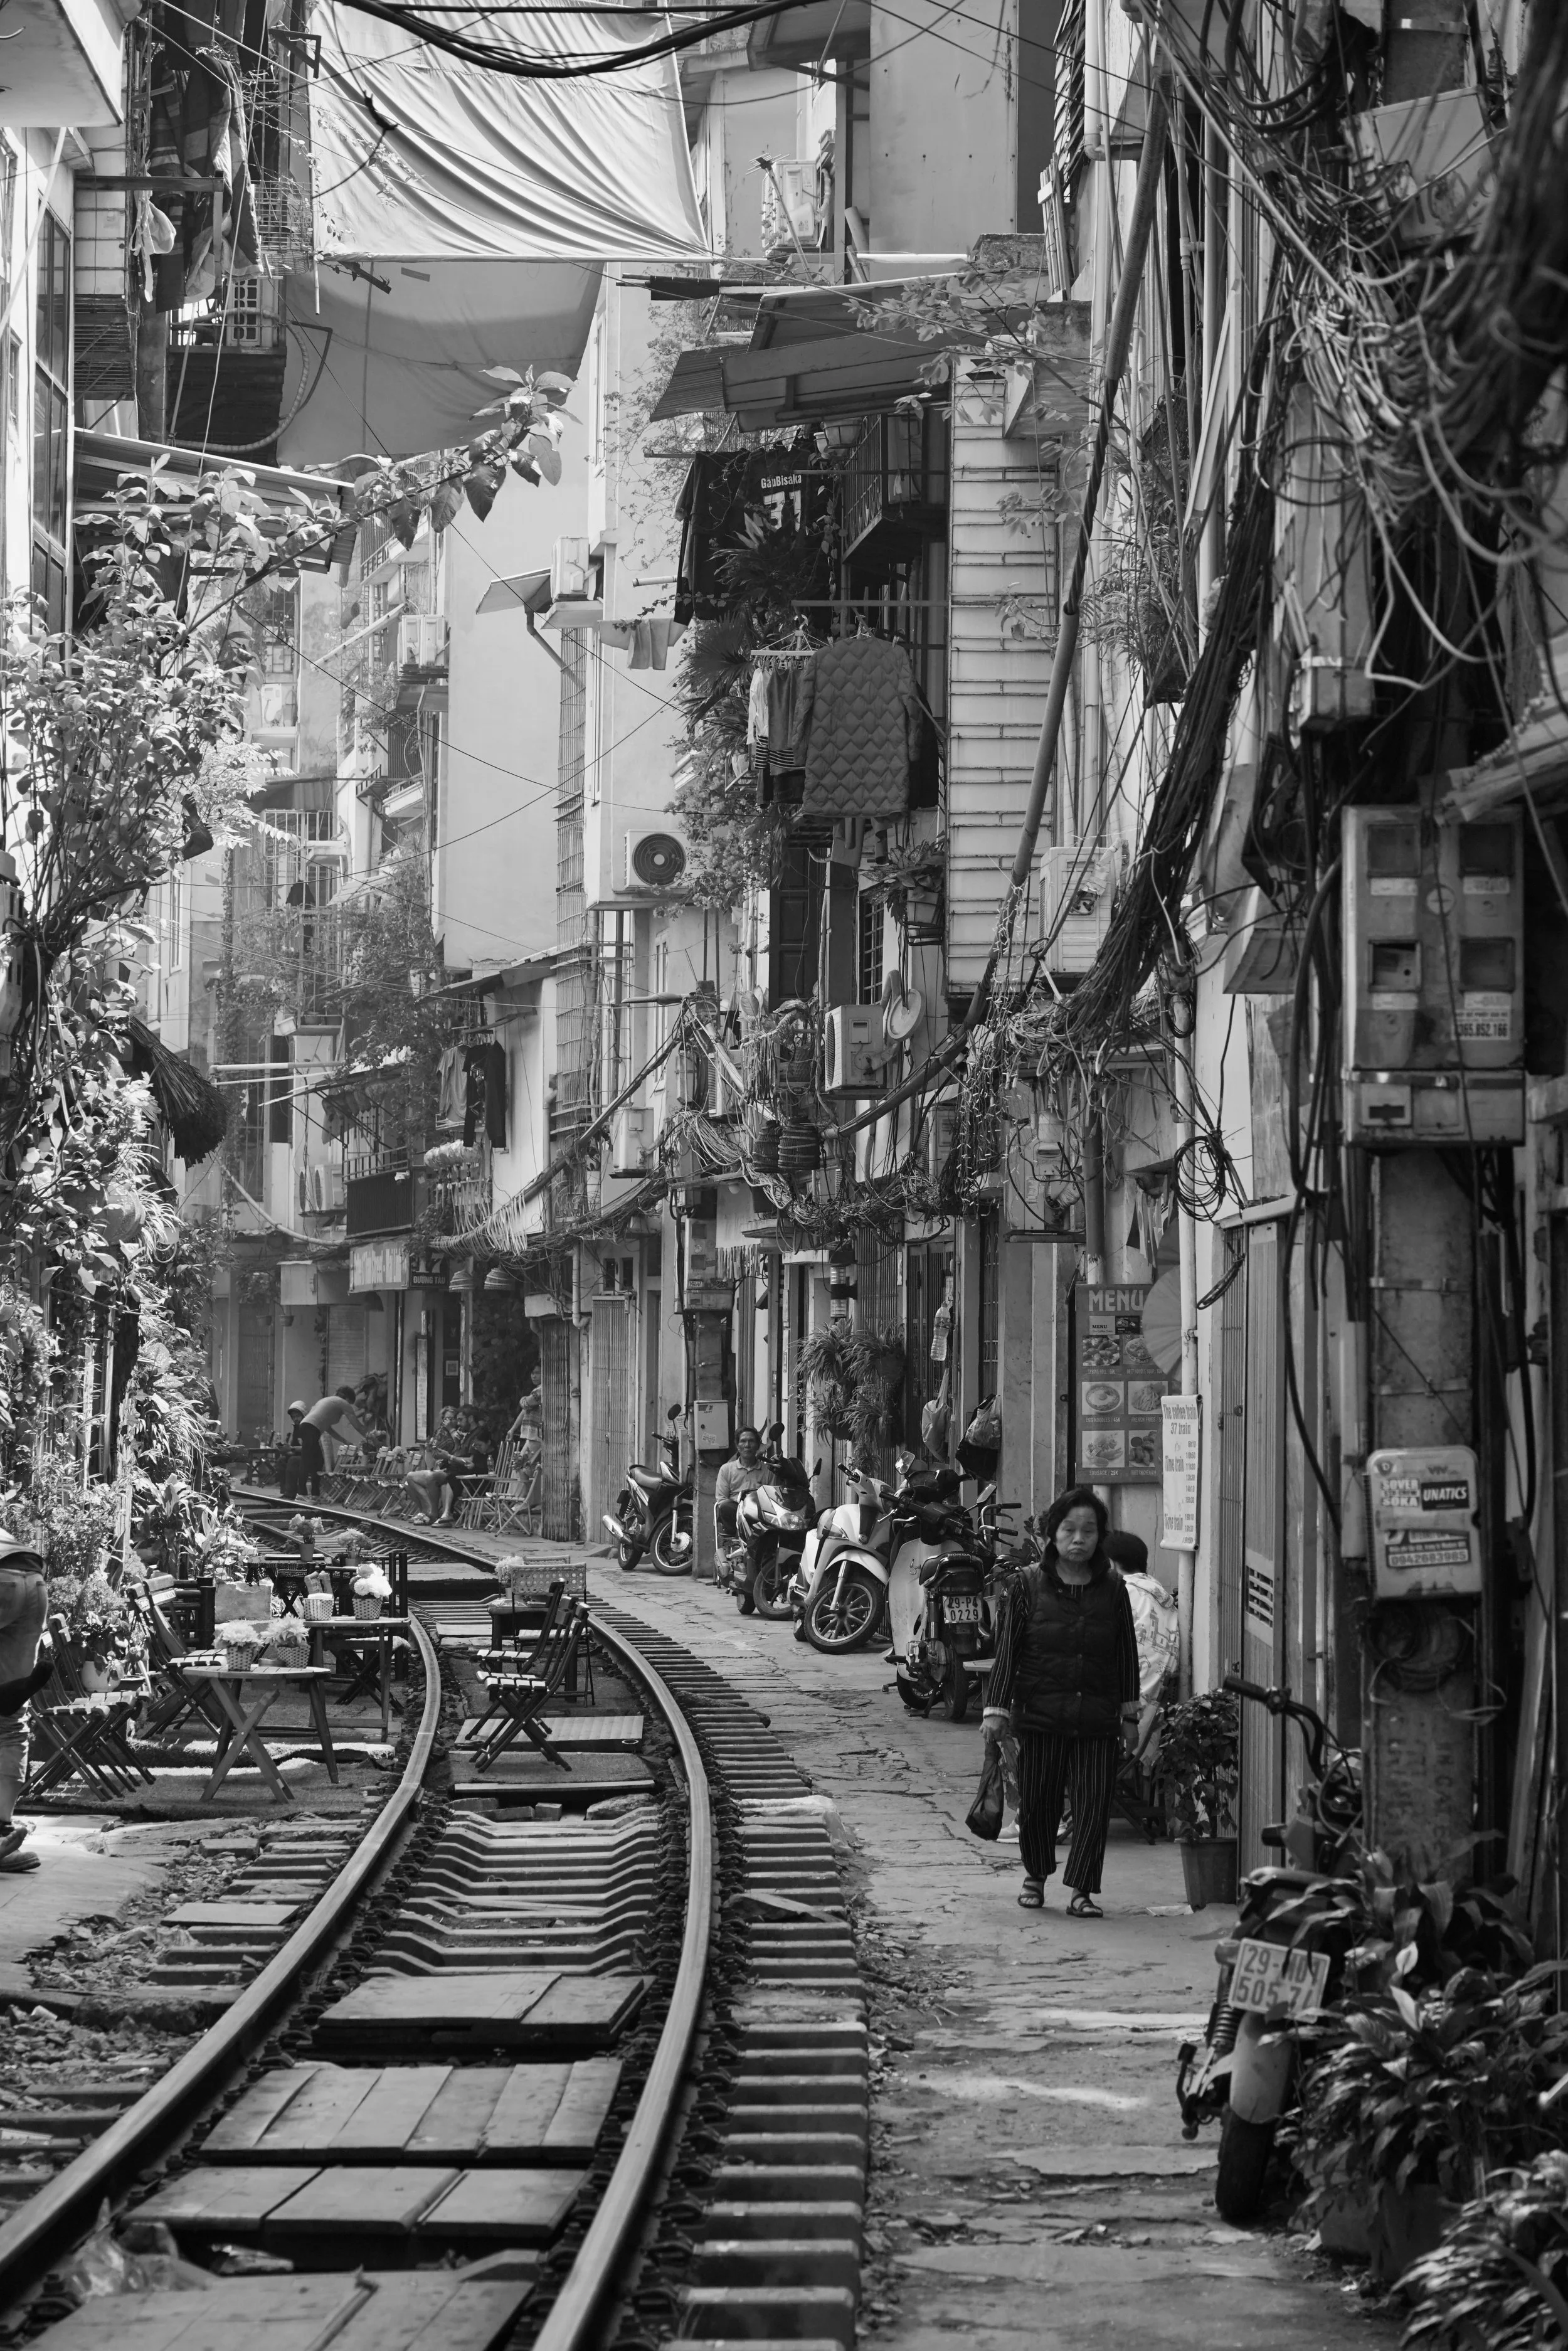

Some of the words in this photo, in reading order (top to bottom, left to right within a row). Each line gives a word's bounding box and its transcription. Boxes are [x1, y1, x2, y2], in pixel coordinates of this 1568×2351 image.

[761, 474, 802, 489] GauBisaka
[763, 490, 802, 532] 31
[1088, 1289, 1143, 1312] MENU
[1163, 1404, 1172, 1420] The
[1172, 1404, 1186, 1420] coffee
[1185, 1404, 1197, 1420] train
[1170, 1422, 1177, 1435] 37
[1179, 1422, 1191, 1435] train
[1165, 1455, 1175, 1472] Time
[1175, 1456, 1184, 1472] train
[1423, 1487, 1467, 1502] UNATICS
[950, 1609, 978, 1621] 0229
